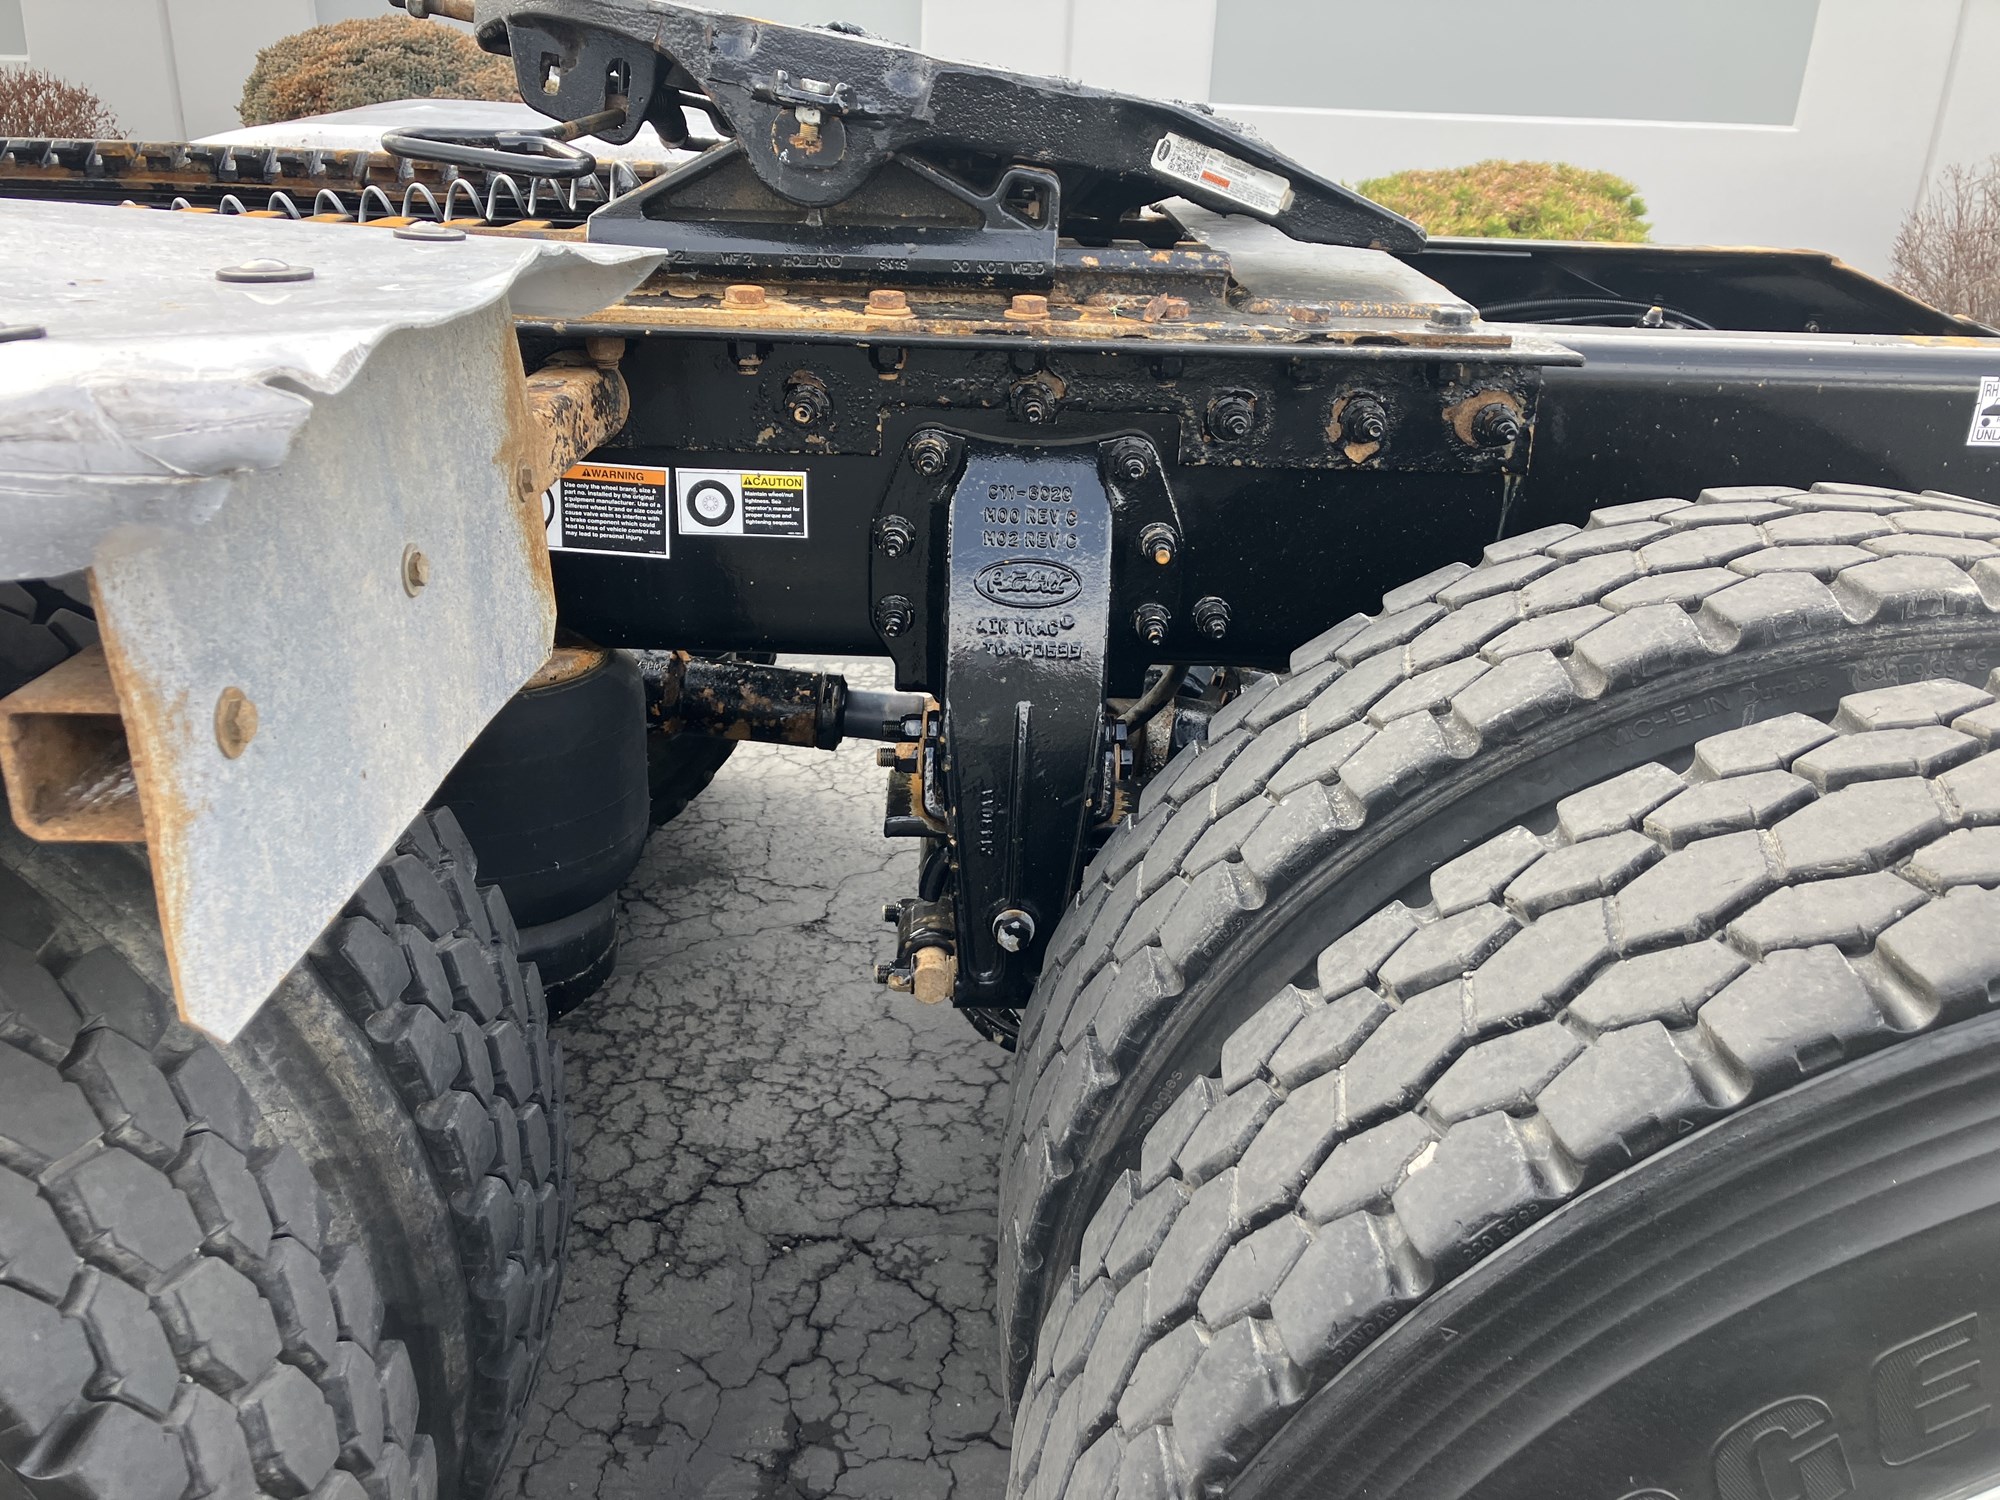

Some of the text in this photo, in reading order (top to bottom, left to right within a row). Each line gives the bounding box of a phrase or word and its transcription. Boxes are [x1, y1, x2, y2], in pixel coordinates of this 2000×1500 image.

[782, 254, 843, 268] HOLLAND
[591, 469, 644, 481] WARNING
[753, 477, 802, 487] CAUTION
[588, 490, 612, 498] installed
[622, 513, 646, 521] interfere
[1025, 507, 1059, 525] REV
[1065, 509, 1078, 527] C
[600, 532, 624, 540] personal
[1024, 531, 1059, 549] REV
[1065, 533, 1078, 549] C
[1601, 694, 1731, 749] MICHELIN
